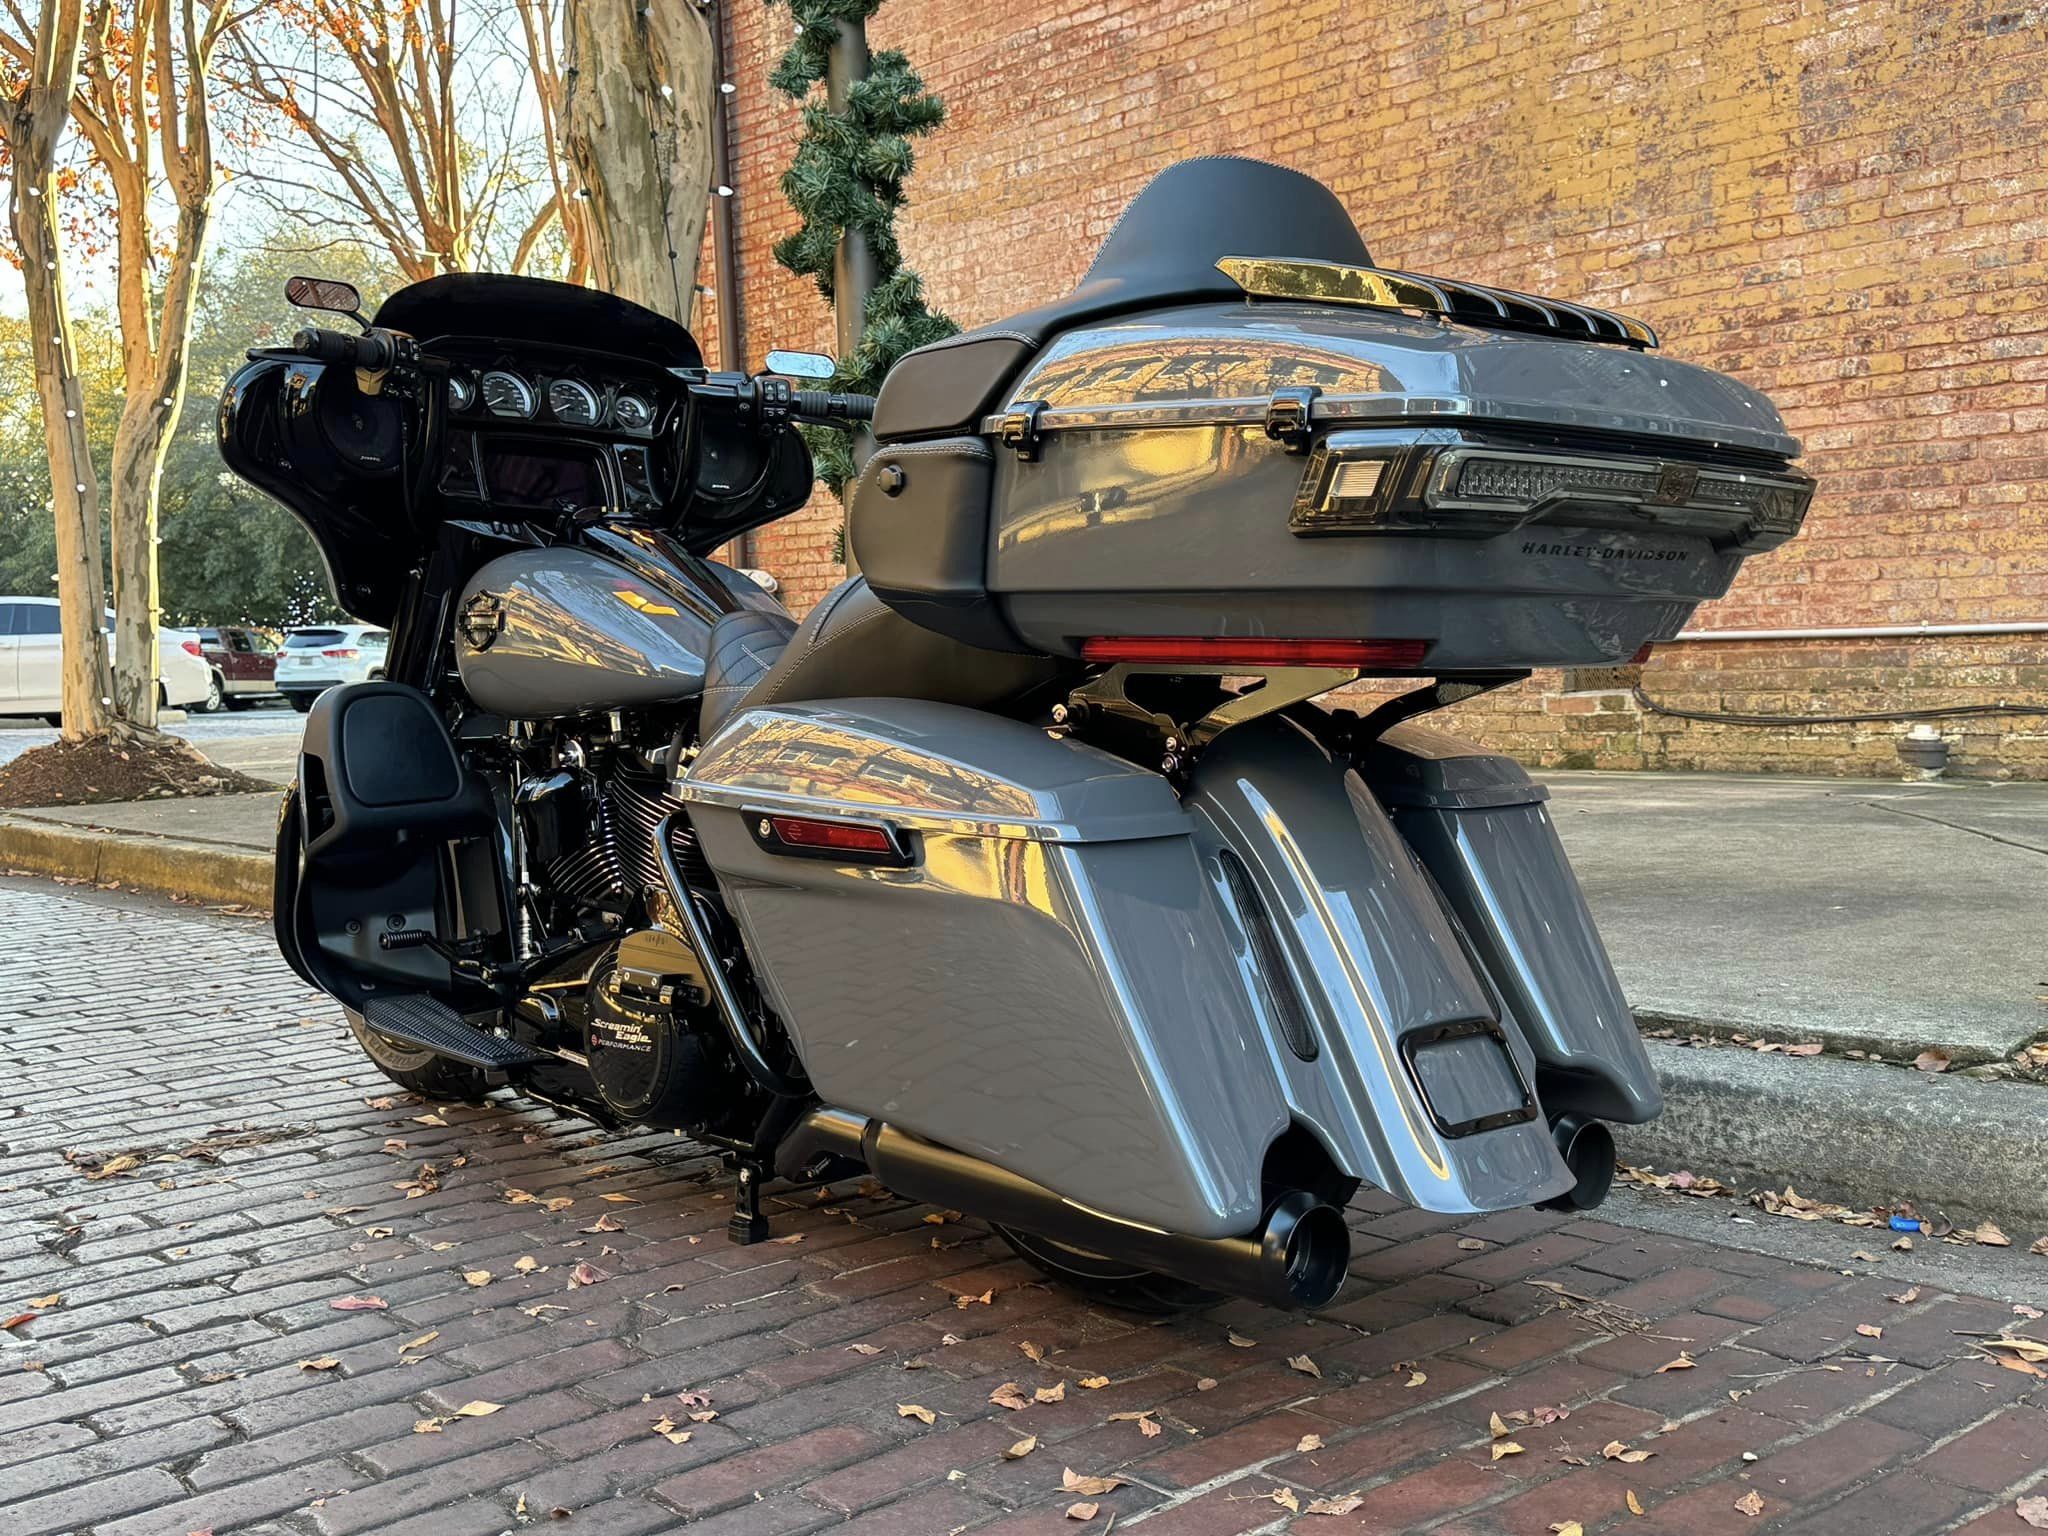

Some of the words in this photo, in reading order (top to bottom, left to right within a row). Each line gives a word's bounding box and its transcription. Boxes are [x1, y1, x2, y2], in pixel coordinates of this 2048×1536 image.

[1522, 542, 1689, 561] HARLEY-DAVIDSON
[590, 1018, 643, 1033] Screamin'
[615, 1031, 652, 1043] Eagle
[598, 1039, 652, 1052] PERFORMANCE
